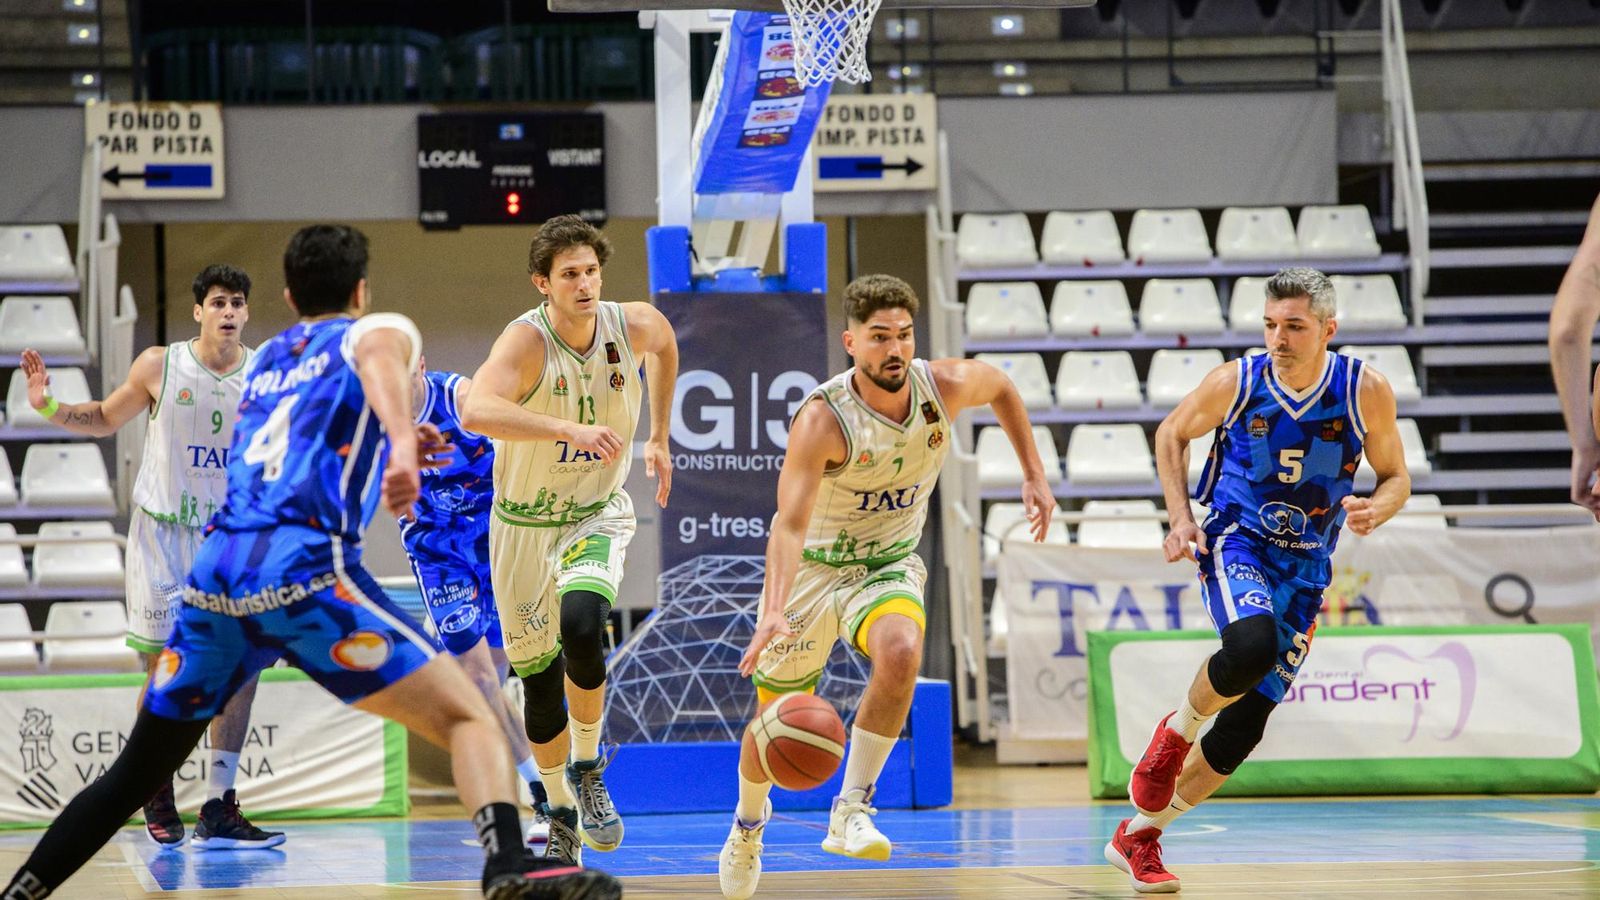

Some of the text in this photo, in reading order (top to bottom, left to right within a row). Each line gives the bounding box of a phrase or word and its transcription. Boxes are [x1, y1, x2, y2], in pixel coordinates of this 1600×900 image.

[108, 111, 202, 130] FONDO D
[826, 103, 915, 123] FONDO D
[153, 136, 213, 153] PISTA
[817, 128, 925, 147] IMP. PISTA
[418, 151, 481, 168] LOCAL
[211, 410, 223, 435] 9
[577, 395, 596, 425] 13
[243, 393, 300, 482] 4
[1277, 448, 1304, 484] 5
[855, 484, 920, 512] TAU
[1286, 631, 1309, 667] 5
